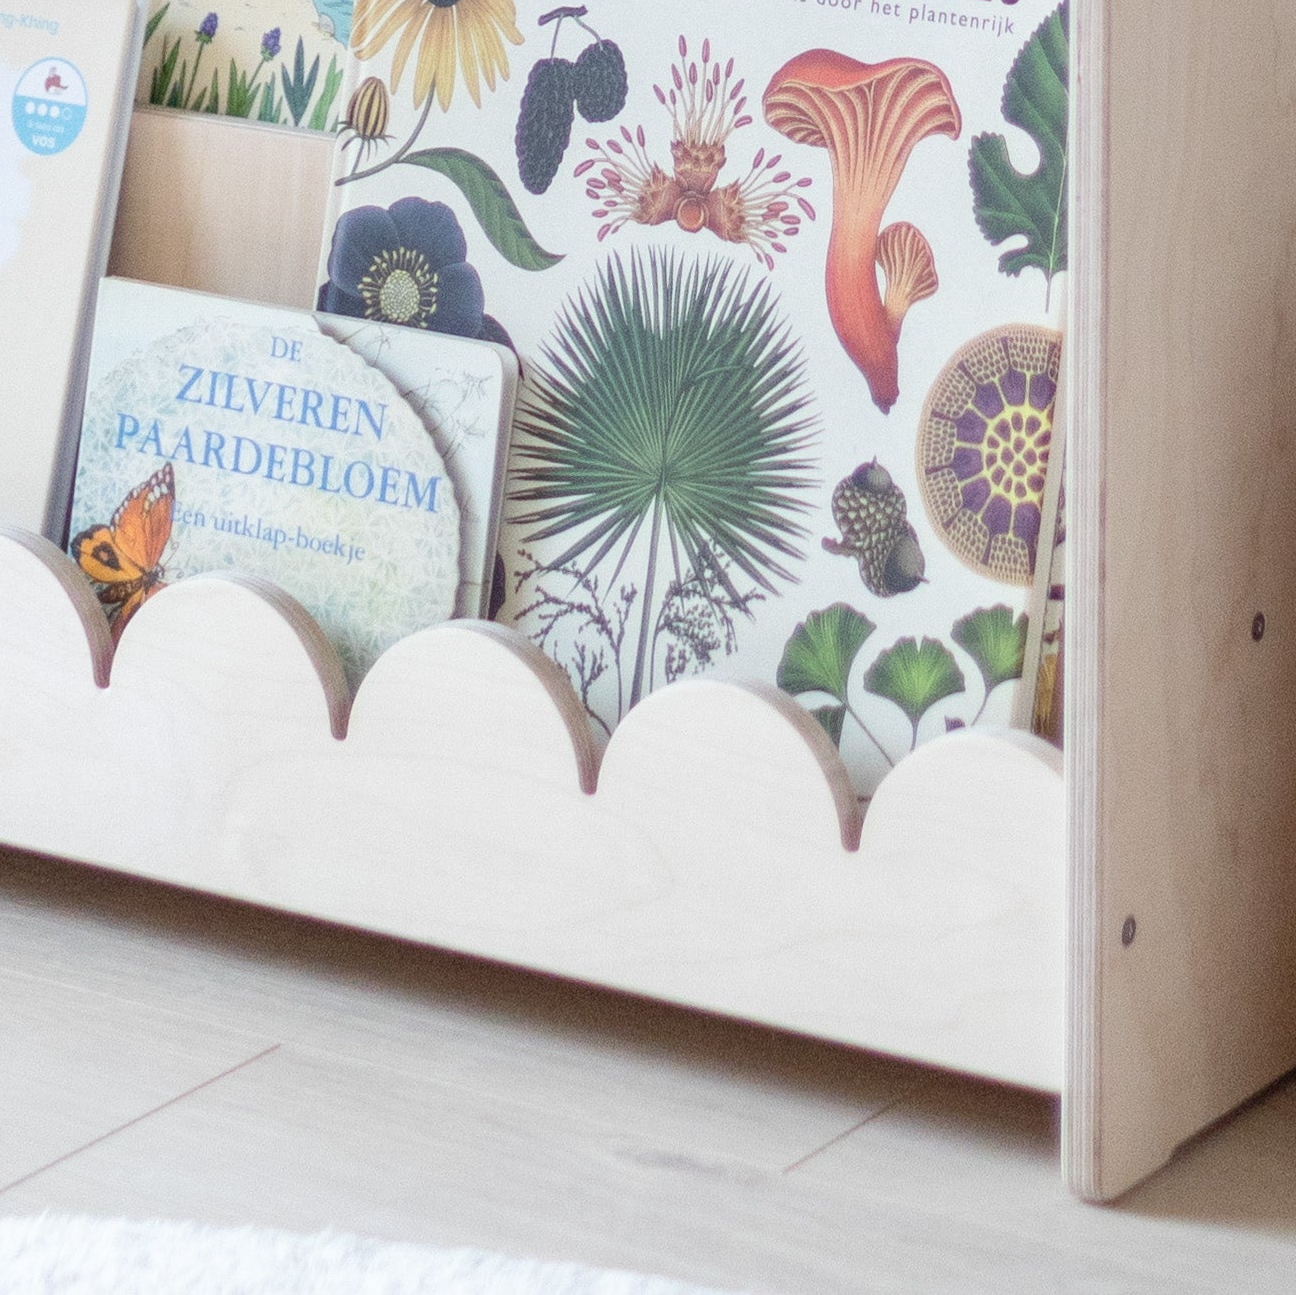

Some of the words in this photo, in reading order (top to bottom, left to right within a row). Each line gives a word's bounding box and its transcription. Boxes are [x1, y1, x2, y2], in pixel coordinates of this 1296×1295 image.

[907, 0, 1017, 38] plantenrijk
[270, 335, 304, 363] DE
[176, 363, 390, 441] ZILVEREN
[113, 412, 444, 513] PAARDEBLOEM
[211, 504, 366, 564] uitklap-boekje
